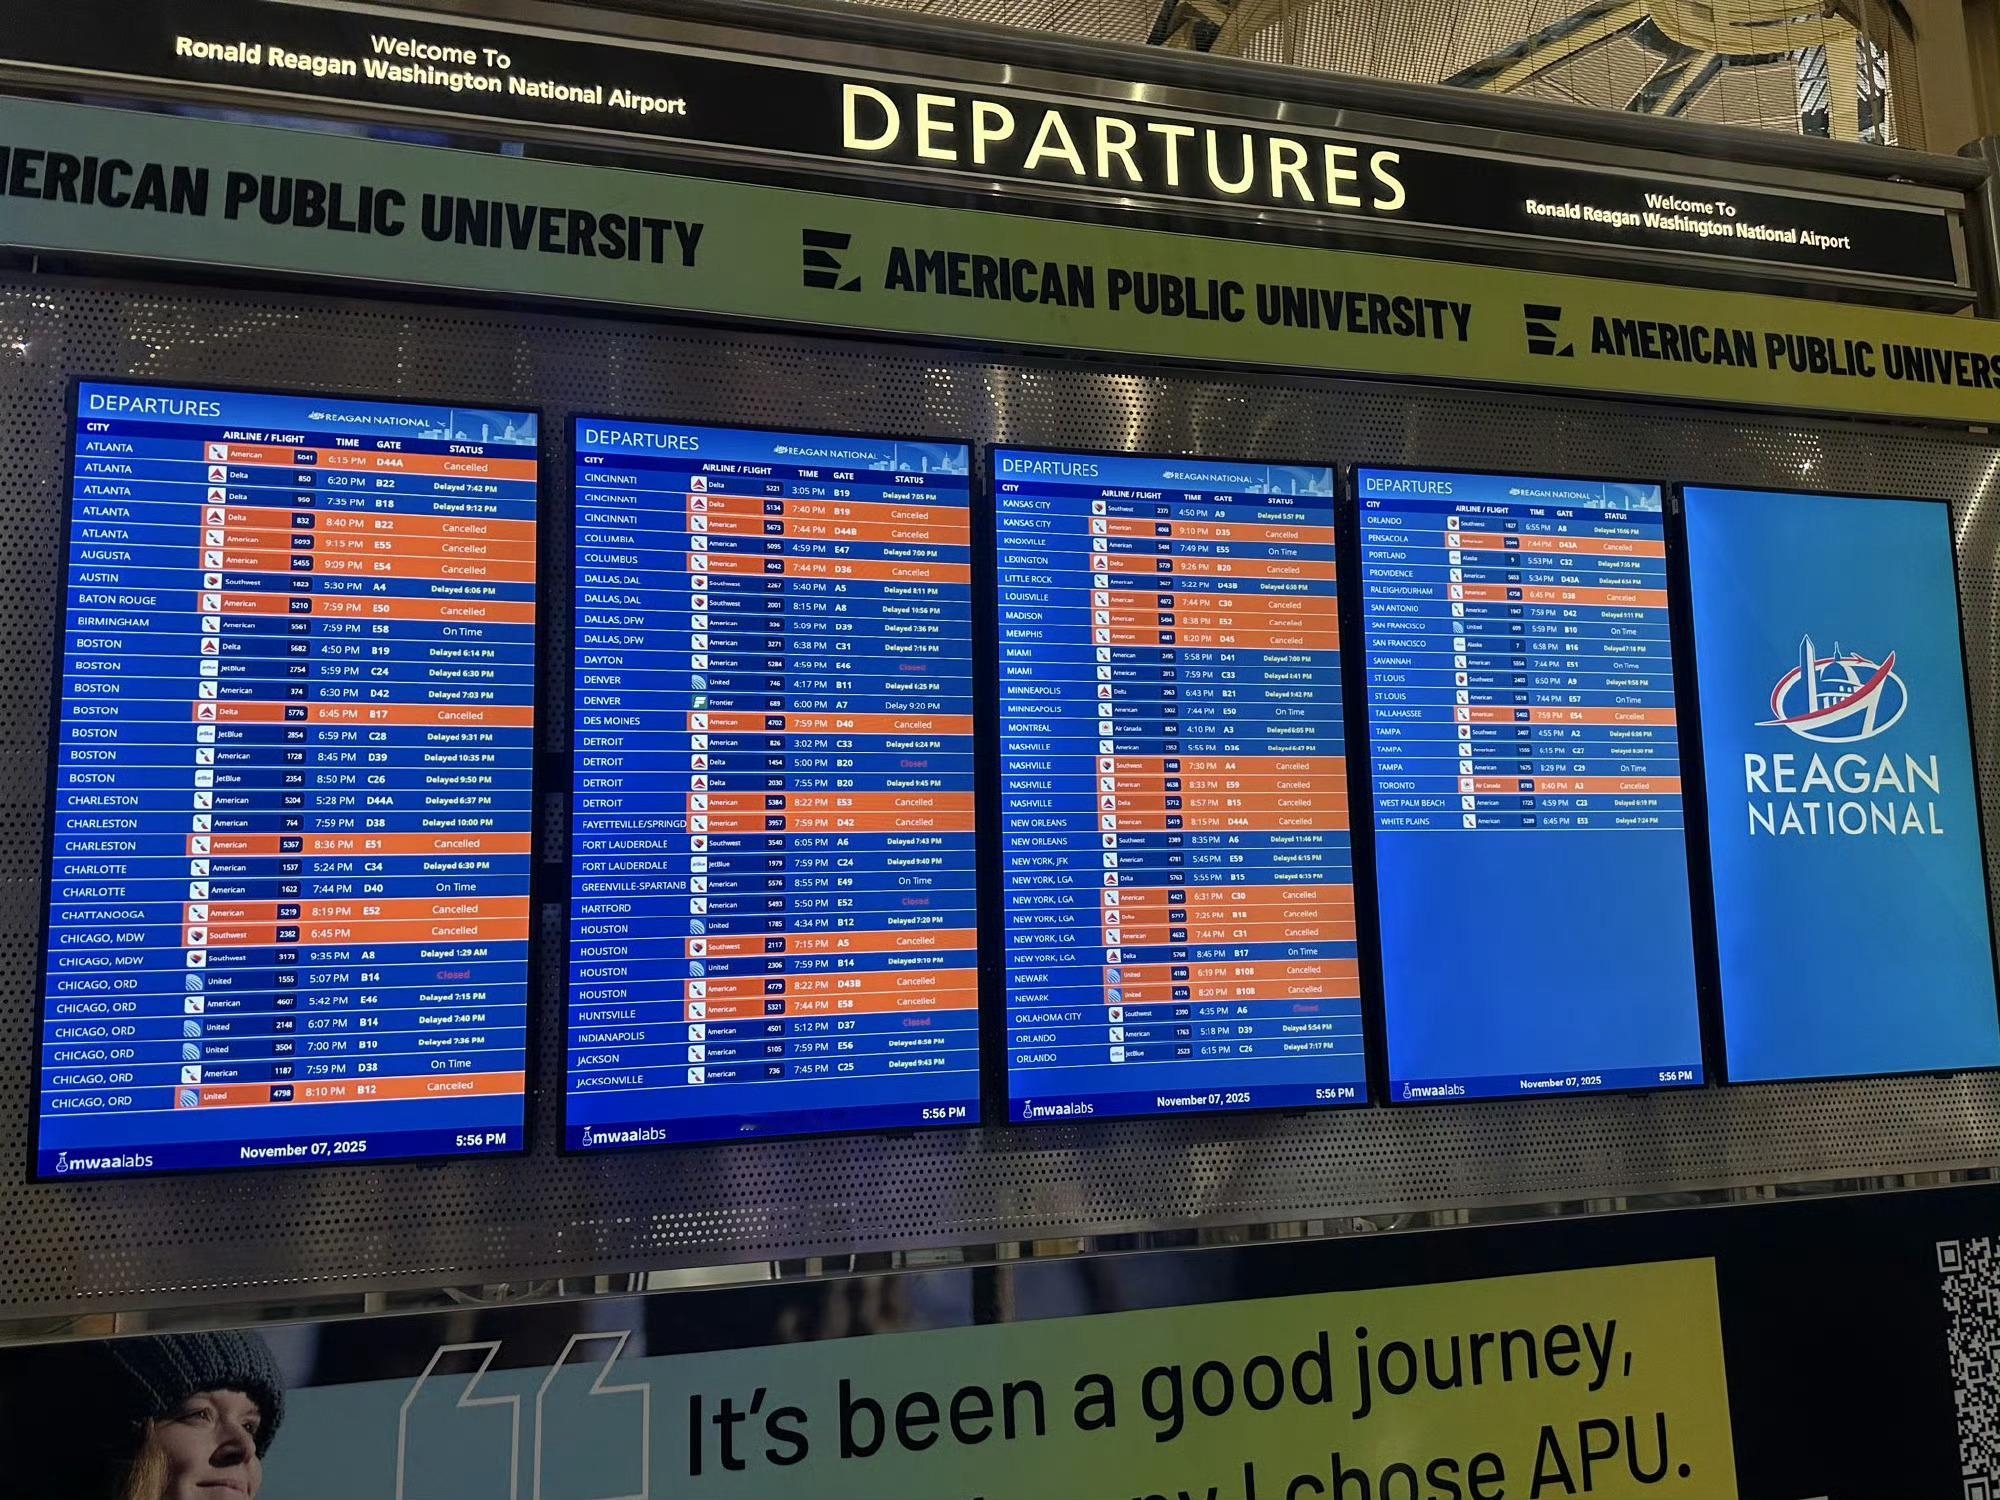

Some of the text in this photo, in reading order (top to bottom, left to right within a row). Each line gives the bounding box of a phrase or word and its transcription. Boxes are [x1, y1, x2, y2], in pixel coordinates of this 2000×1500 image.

[371, 35, 510, 69] Welcome To
[176, 37, 686, 115] Ronald Reagan Washington National Airport
[842, 83, 1407, 211] DEPARTURES
[1645, 194, 1736, 216] Welcome To
[225, 172, 405, 237] PUBLIC
[421, 193, 705, 268] UNIVERSITY
[1526, 200, 1850, 250] Ronald Reagan Washington National Airport
[884, 246, 1472, 343] AMERICAN PUBLIC UNIVERSITY
[1591, 316, 1758, 368] AMERICAN
[1765, 332, 1878, 378] PUBLIC
[90, 394, 220, 416] DEPARTURES
[326, 414, 430, 427] REAGAN NATIONAL
[87, 422, 110, 431] CITY
[223, 431, 262, 441] AIRLINE
[271, 433, 305, 444] FLIGHT
[336, 438, 359, 447] TIME
[377, 440, 401, 450] GATE
[449, 445, 483, 454] STATUS
[586, 429, 699, 450] DEPARTURES
[789, 447, 878, 459] REAGAN NATIONAL
[584, 456, 604, 464] CITY
[702, 464, 735, 472] AIRLINE
[743, 466, 772, 474] FLIGHT
[798, 470, 818, 478] TIME
[833, 472, 854, 480] GATE
[895, 476, 924, 484] STATUS
[1003, 459, 1098, 476] DEPARTURES
[1367, 478, 1452, 494] DEPARTURES
[584, 554, 638, 564] COLUMBUS
[892, 568, 930, 576] Cancelled
[79, 594, 116, 604] BATON
[119, 596, 156, 605] ROUGE
[324, 602, 343, 611] 7:59
[346, 603, 361, 612] PM
[440, 607, 485, 616] Cancelled
[73, 706, 118, 714] BOSTON
[319, 709, 340, 718] 6:45
[342, 710, 358, 718] PM
[370, 710, 388, 718] B17
[438, 711, 483, 720] Cancelled
[584, 716, 602, 724] DES
[604, 717, 640, 725] MOINES
[814, 720, 828, 728] PM
[836, 720, 854, 728] D40
[894, 721, 932, 729] Cancelled
[1744, 752, 1940, 794] REAGAN
[1748, 801, 1944, 836] NATIONAL
[62, 910, 144, 920] CHATTANOOGA
[312, 907, 334, 916] 8:19
[336, 907, 351, 915] PM
[363, 906, 380, 915] E52
[432, 905, 478, 914] Cancelled
[580, 946, 628, 956] HOUSTON
[794, 940, 813, 948] 7:15
[815, 940, 828, 948] PM
[837, 939, 849, 947] A5
[896, 936, 935, 945] Cancelled
[1520, 1076, 1602, 1088] November 07, 2025
[1659, 1072, 1676, 1081] 5:56
[52, 1098, 105, 1108] CHICAGO,
[108, 1096, 132, 1106] ORD
[306, 1087, 328, 1096] 8:10
[330, 1086, 345, 1095] PM
[358, 1085, 376, 1094] B12
[427, 1082, 474, 1091] Cancelled
[1157, 1092, 1250, 1107] November 07, 2025
[1316, 1088, 1336, 1098] 5:56
[1412, 1084, 1465, 1097] mwaalabs
[923, 1106, 965, 1119] 5:56 PM
[1033, 1102, 1094, 1116] mwaalabs
[456, 1133, 506, 1146] 5:56 PM
[594, 1127, 666, 1144] mwaalabs
[240, 1140, 366, 1158] November 07, 2025
[70, 1154, 153, 1170] mwaalabs
[839, 1378, 1045, 1459] been
[1073, 1373, 1117, 1431] a
[1141, 1330, 1333, 1443] good
[1351, 1319, 1633, 1420] journey,
[1529, 1412, 1691, 1500] APU.
